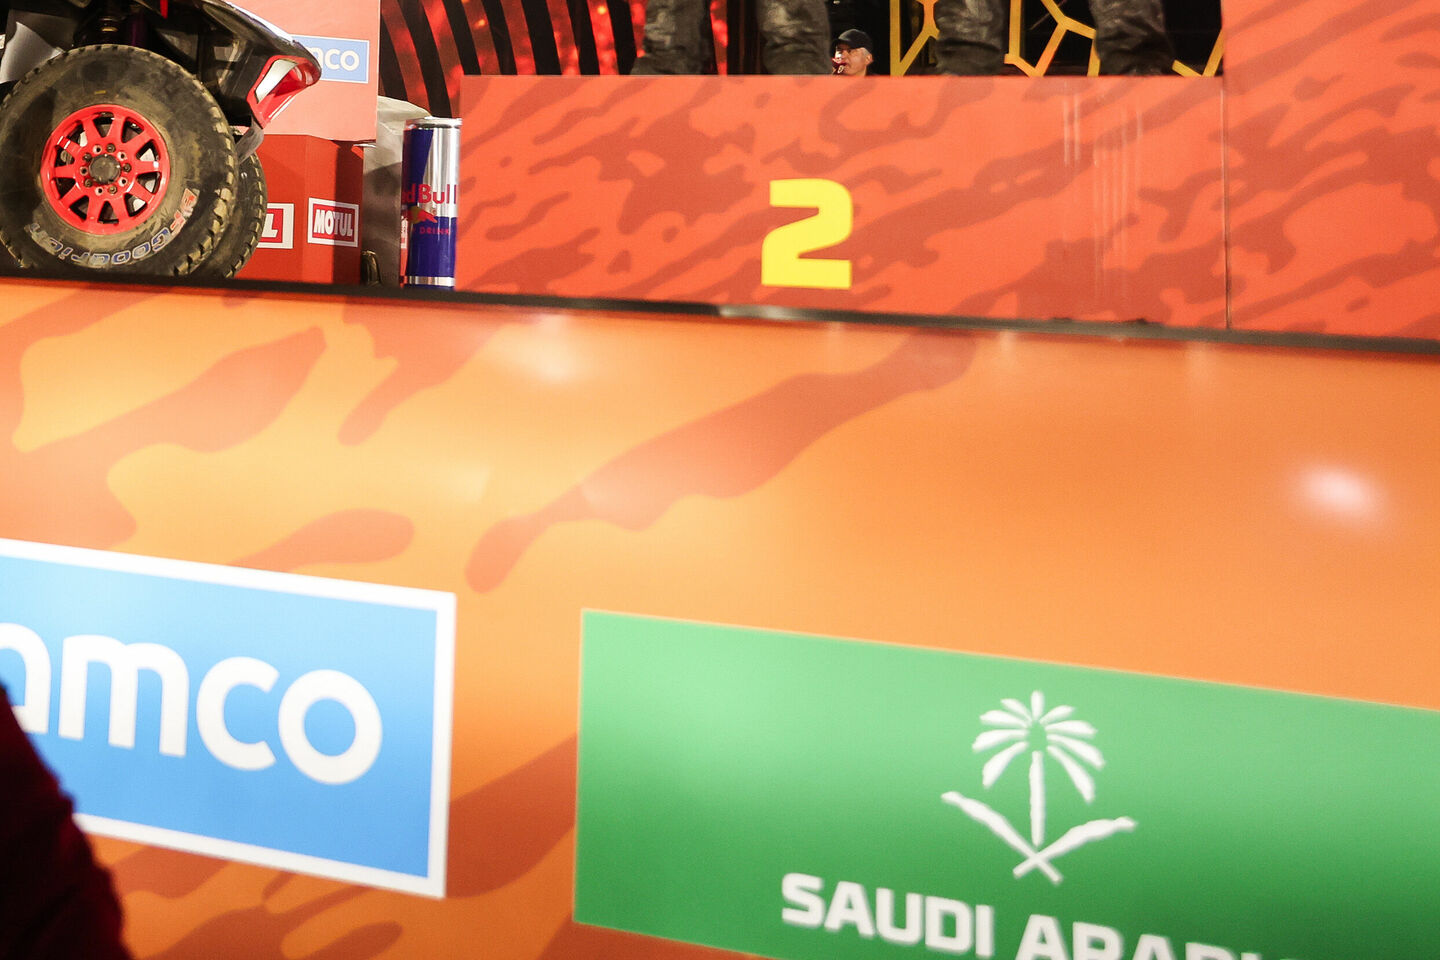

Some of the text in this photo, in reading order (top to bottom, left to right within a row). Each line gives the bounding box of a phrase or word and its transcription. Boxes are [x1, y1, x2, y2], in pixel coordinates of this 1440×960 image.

[418, 184, 457, 204] Bull
[313, 209, 354, 237] MOTUL
[761, 178, 853, 290] 2
[781, 872, 995, 958] SAUDI
